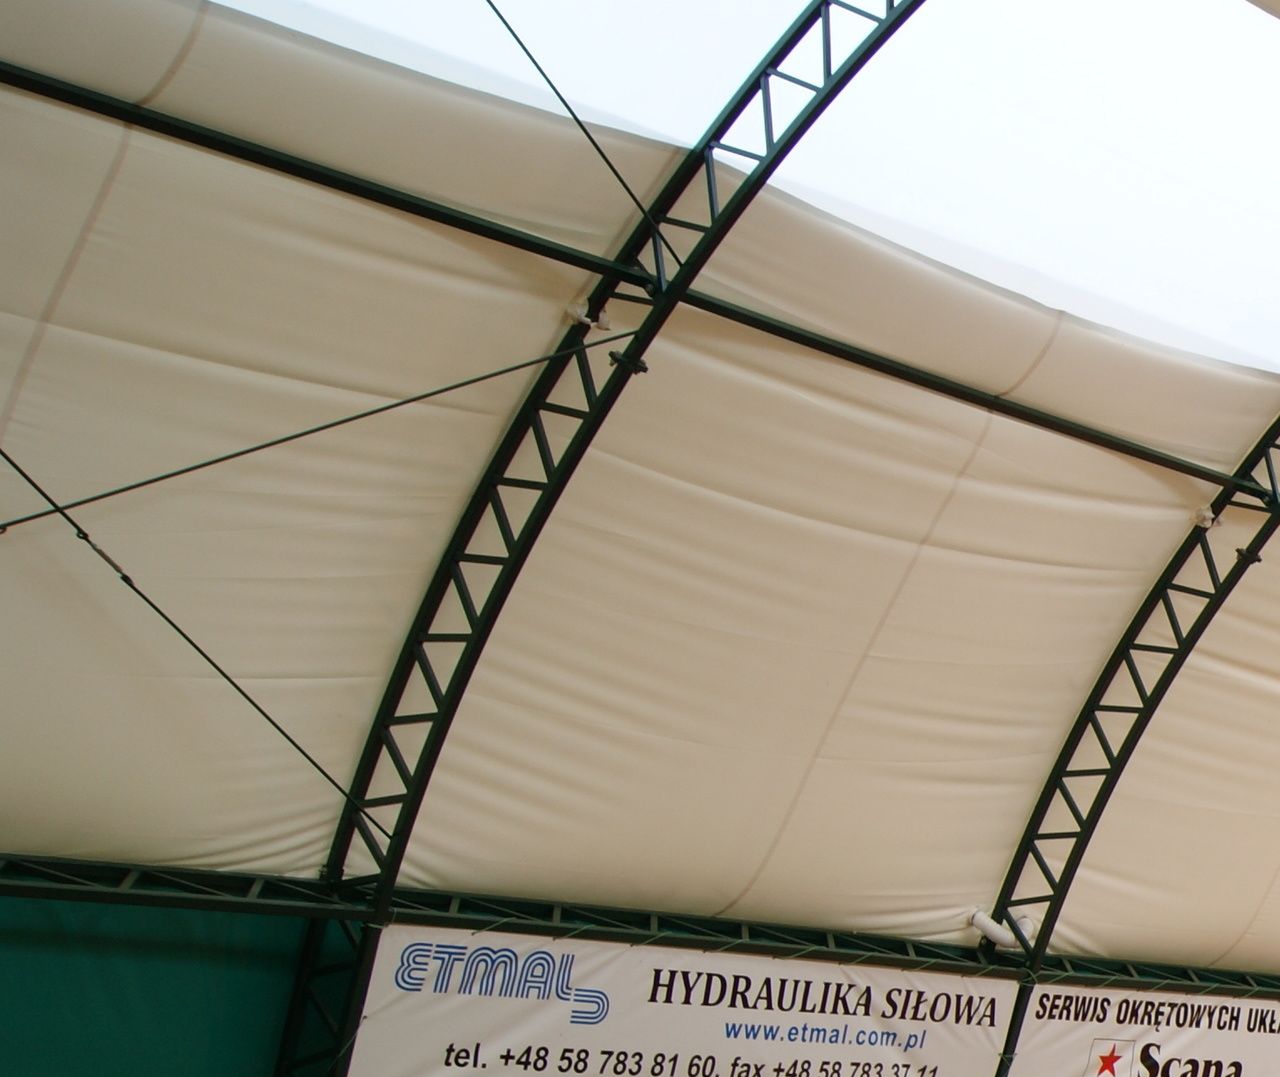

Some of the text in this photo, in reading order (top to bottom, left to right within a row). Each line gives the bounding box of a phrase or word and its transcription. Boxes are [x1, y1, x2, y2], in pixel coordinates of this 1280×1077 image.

[648, 968, 996, 1027] HYDRAULIKA SIŁOWA
[1036, 993, 1110, 1023] SERWIS
[1116, 999, 1241, 1032] OKRĘTOWYCH
[724, 1022, 926, 1051] www.etmal.com.pl
[444, 1042, 487, 1068] tel.
[499, 1046, 549, 1072] +48
[557, 1048, 590, 1074] 58
[599, 1050, 643, 1076] 783
[650, 1053, 679, 1077] 81
